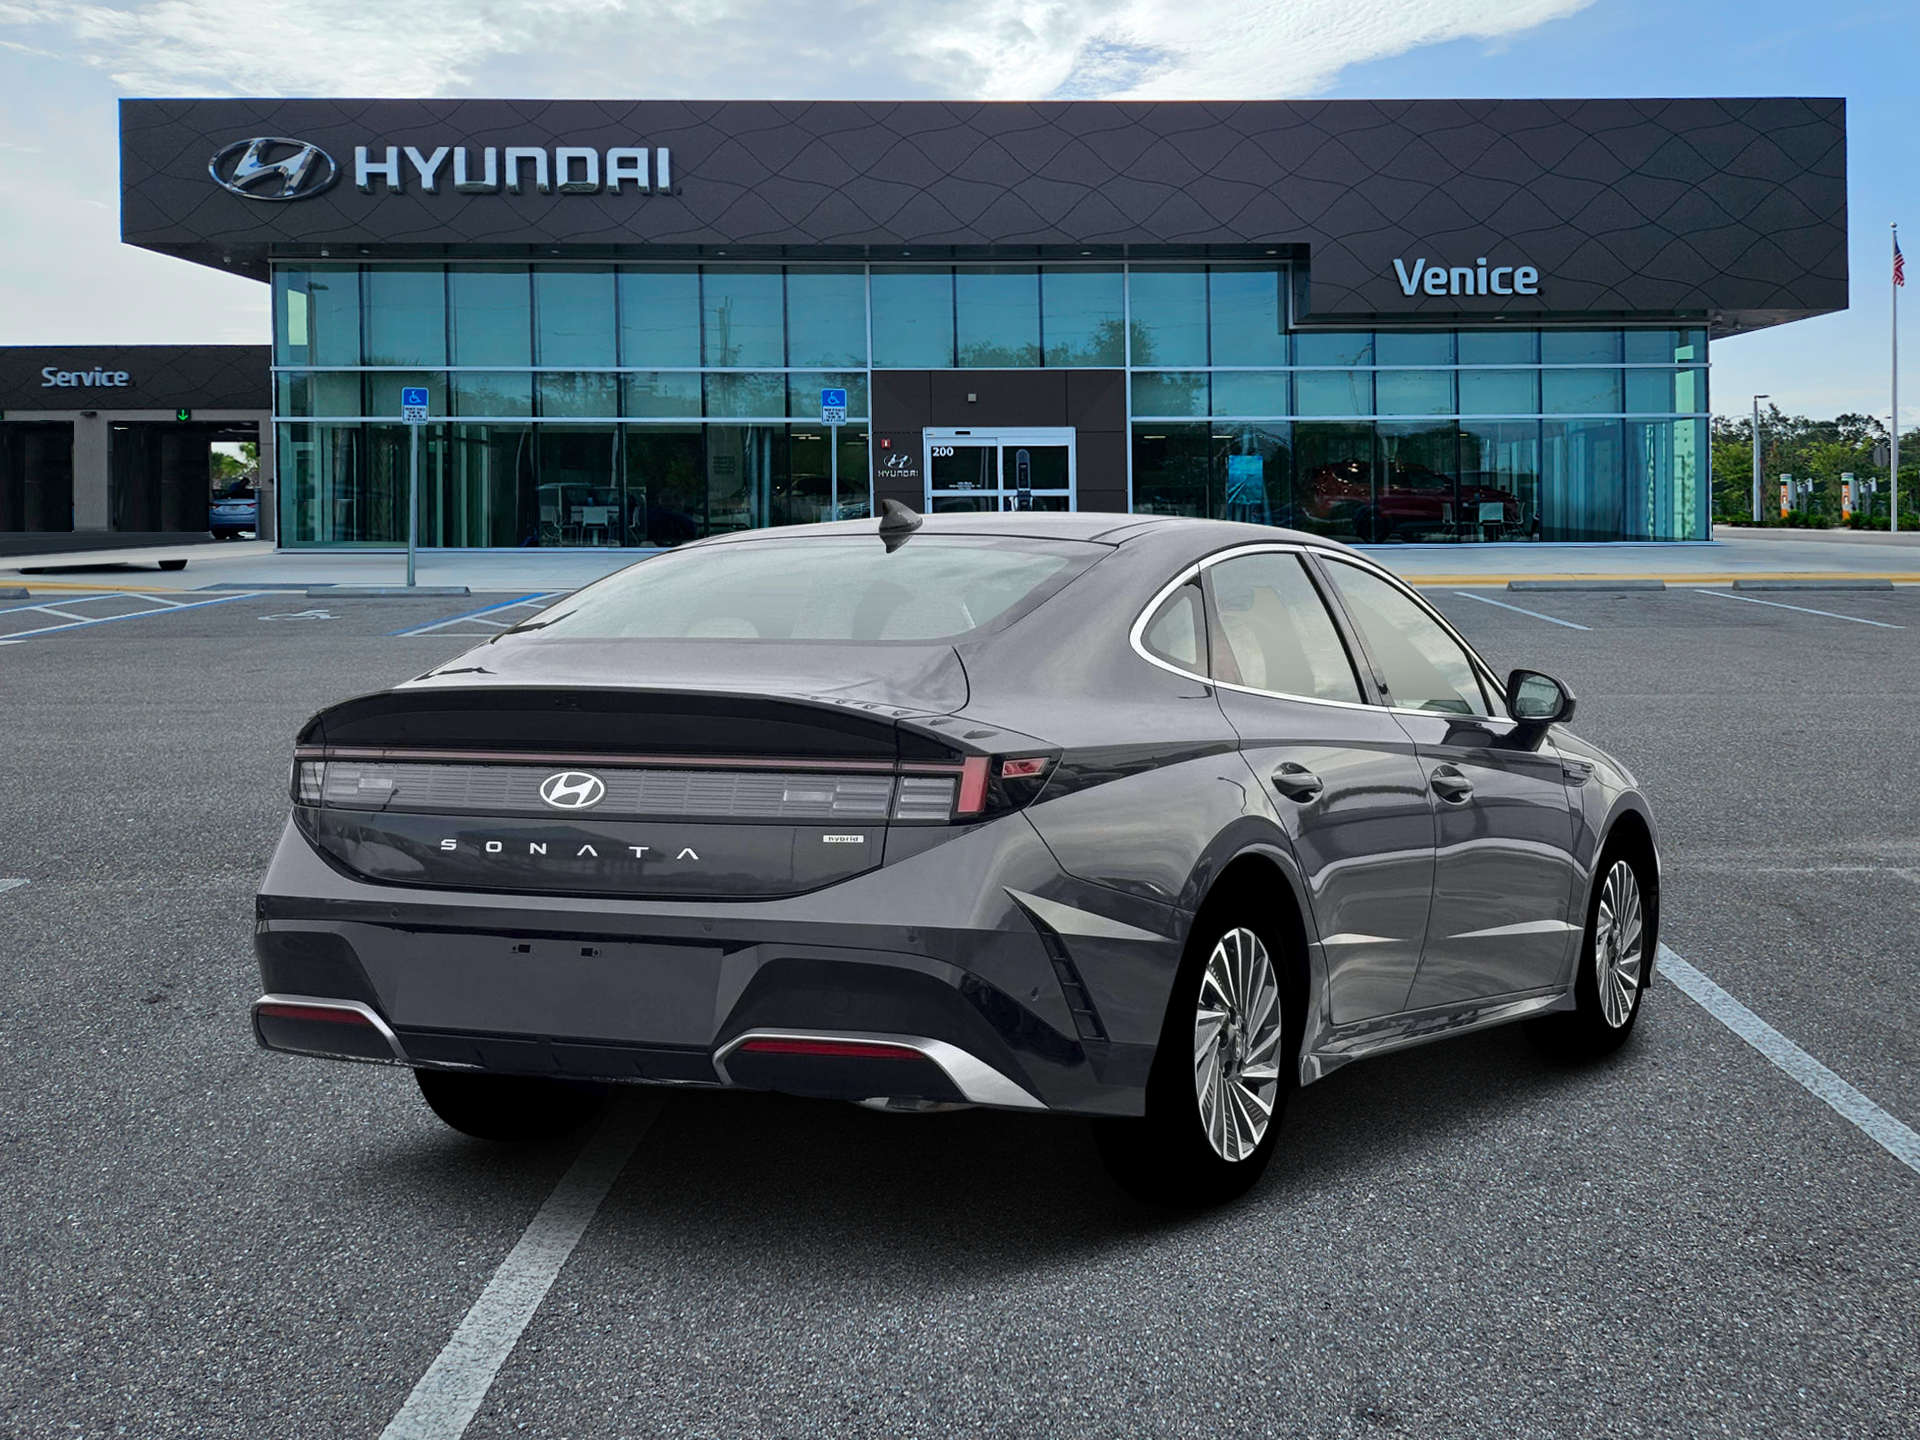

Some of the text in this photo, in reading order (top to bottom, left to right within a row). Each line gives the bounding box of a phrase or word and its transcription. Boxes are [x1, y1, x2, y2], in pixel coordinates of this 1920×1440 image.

[355, 146, 671, 194] HYUNDAI
[1393, 257, 1539, 296] Venice
[41, 366, 130, 387] Service
[932, 447, 954, 457] 200
[877, 469, 919, 478] HYUNDAI
[440, 839, 699, 860] SONATA
